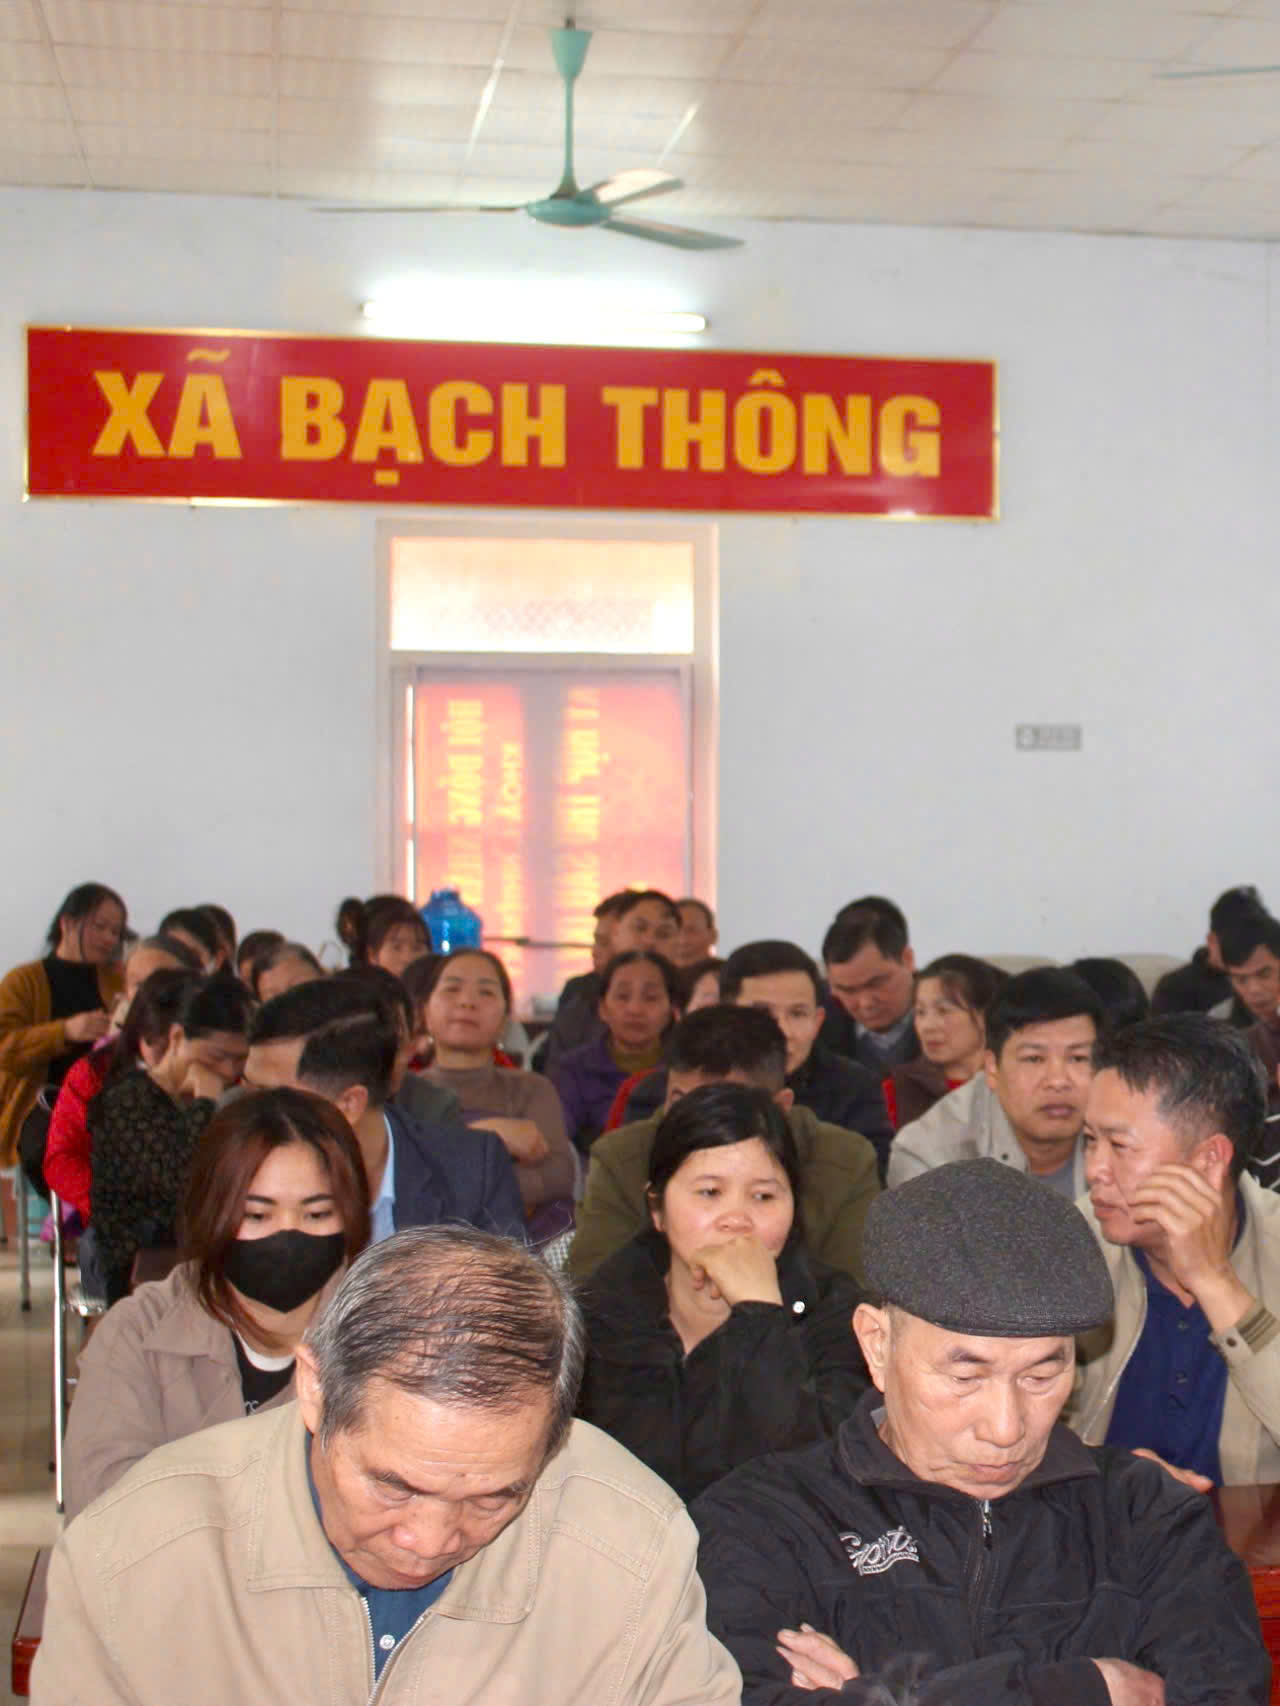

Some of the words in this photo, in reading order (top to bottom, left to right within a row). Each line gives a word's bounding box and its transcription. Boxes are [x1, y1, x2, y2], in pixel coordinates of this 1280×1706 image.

[92, 348, 242, 460] XÃ
[279, 374, 567, 486] BẠCH
[602, 369, 943, 479] THÔNG
